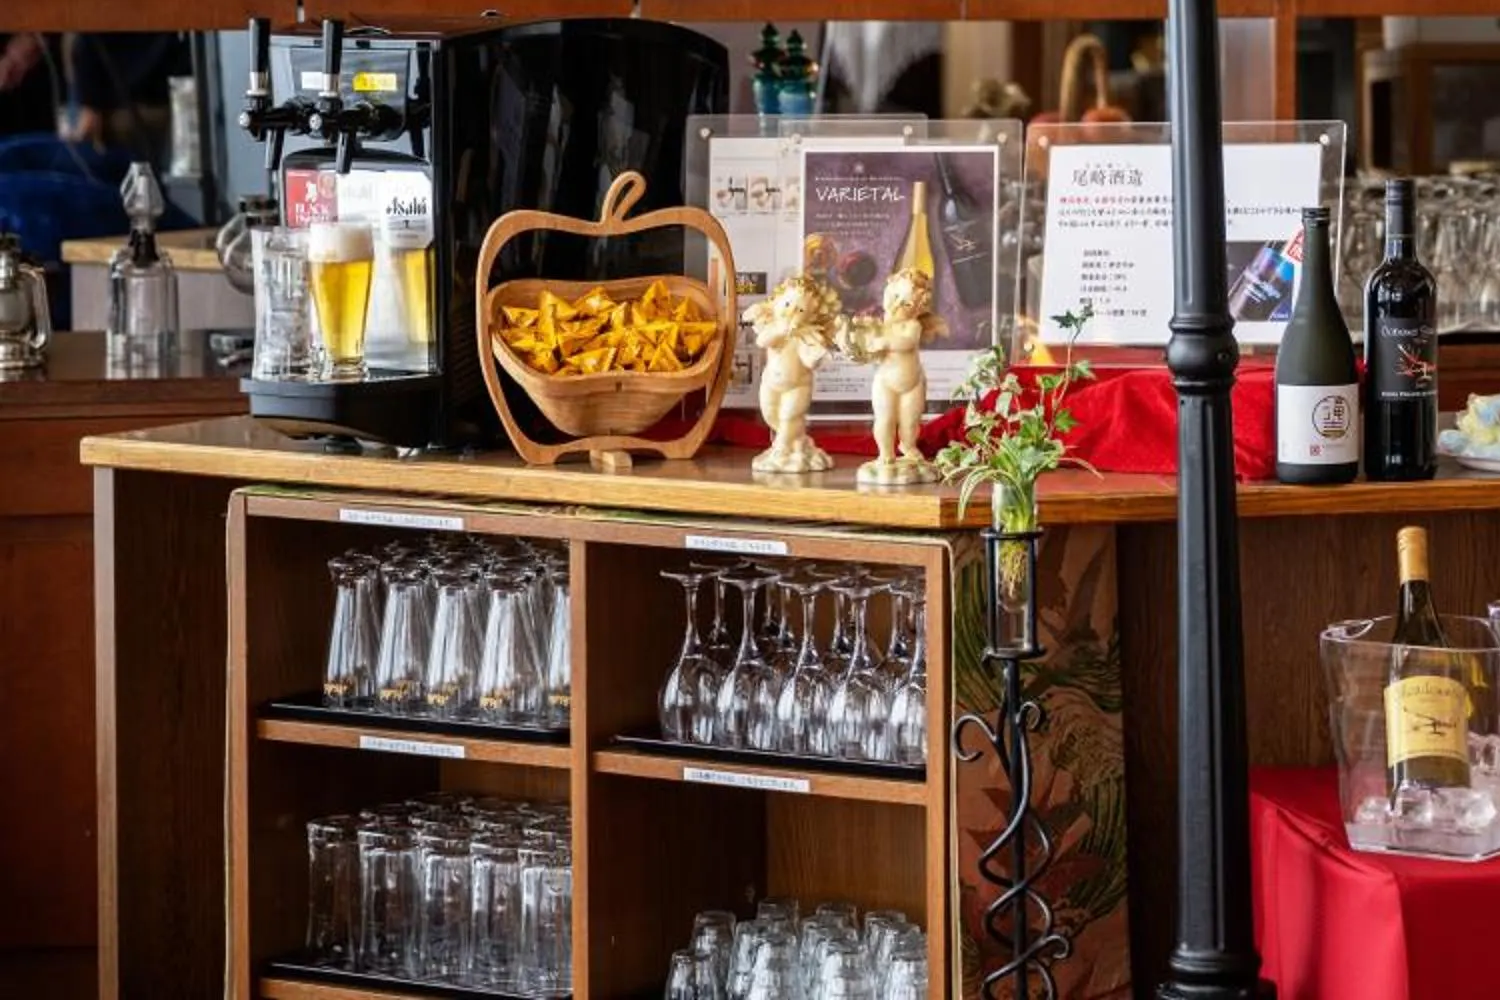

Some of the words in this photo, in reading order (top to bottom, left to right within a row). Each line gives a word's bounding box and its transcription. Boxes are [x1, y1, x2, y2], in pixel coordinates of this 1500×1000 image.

[1071, 169, 1143, 186] 尾崎酒造
[815, 186, 906, 203] VARIETAL
[386, 197, 427, 215] Asahi
